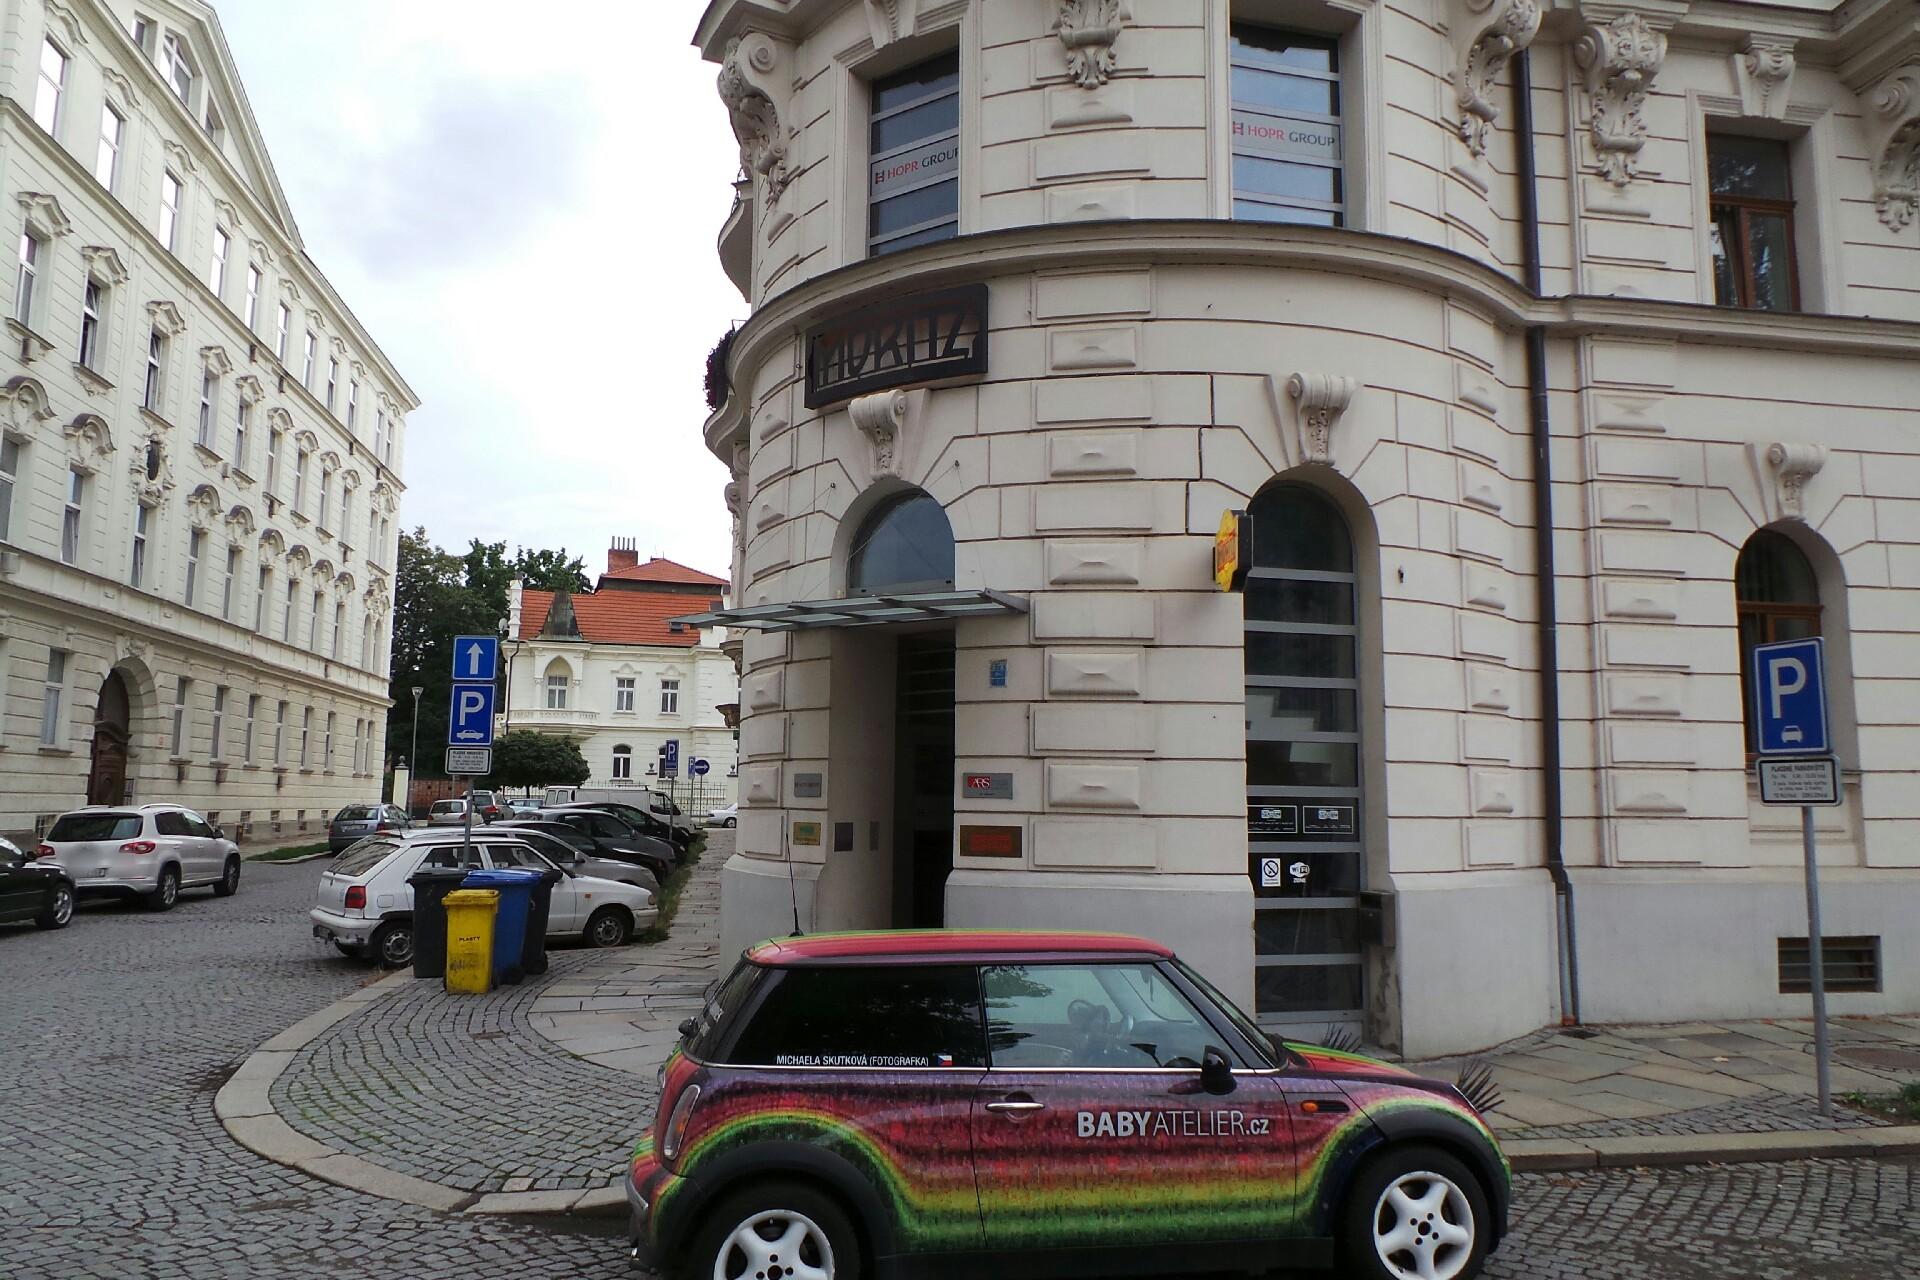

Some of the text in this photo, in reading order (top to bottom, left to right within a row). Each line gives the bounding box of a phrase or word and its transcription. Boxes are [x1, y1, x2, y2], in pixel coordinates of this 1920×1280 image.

[1248, 124, 1285, 141] HOPR
[1289, 131, 1335, 147] GROUP
[887, 160, 919, 180] HOPR
[1768, 657, 1806, 719] P
[459, 691, 485, 726] P
[972, 777, 990, 789] ARS
[776, 1053, 929, 1067] MICHAELA SKUTKOVÁ (FOTOGRAFKA)
